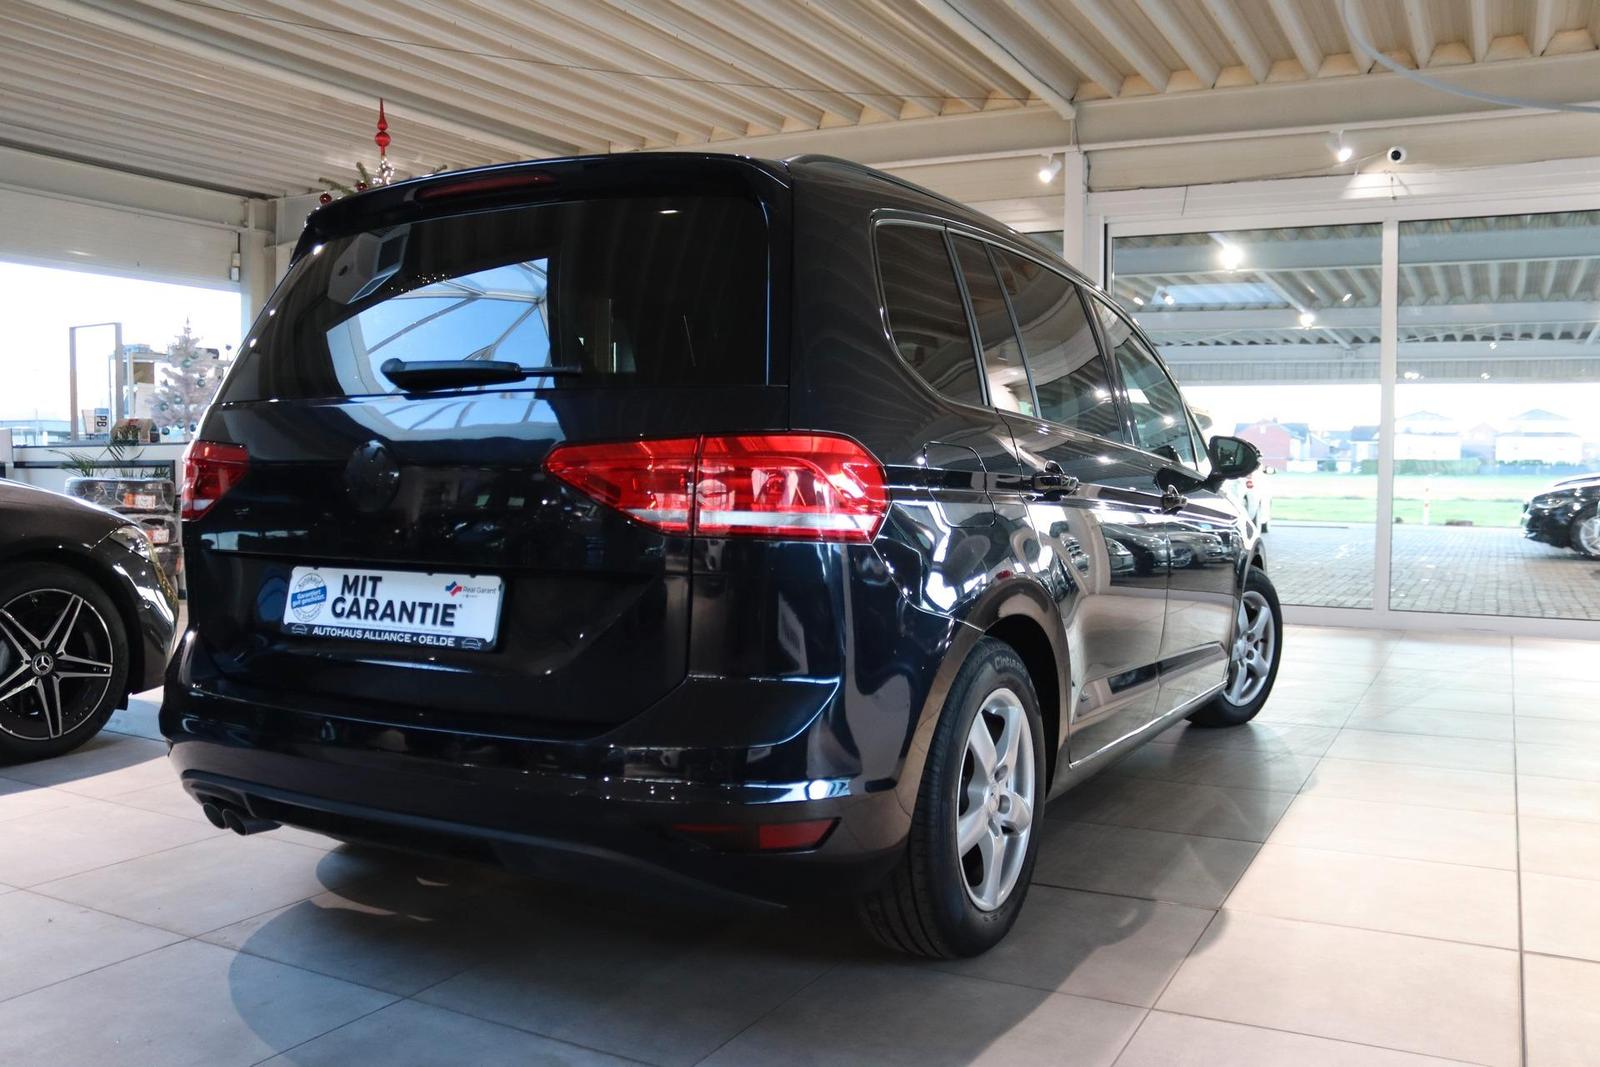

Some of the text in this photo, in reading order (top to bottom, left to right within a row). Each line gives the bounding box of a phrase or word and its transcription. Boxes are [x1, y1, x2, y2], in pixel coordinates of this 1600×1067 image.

[341, 574, 382, 598] MIT
[331, 596, 457, 627] GARANTIE
[312, 626, 363, 639] AUTOHAUS
[364, 631, 411, 643] ALLIANCE
[418, 636, 455, 647] OELDE
